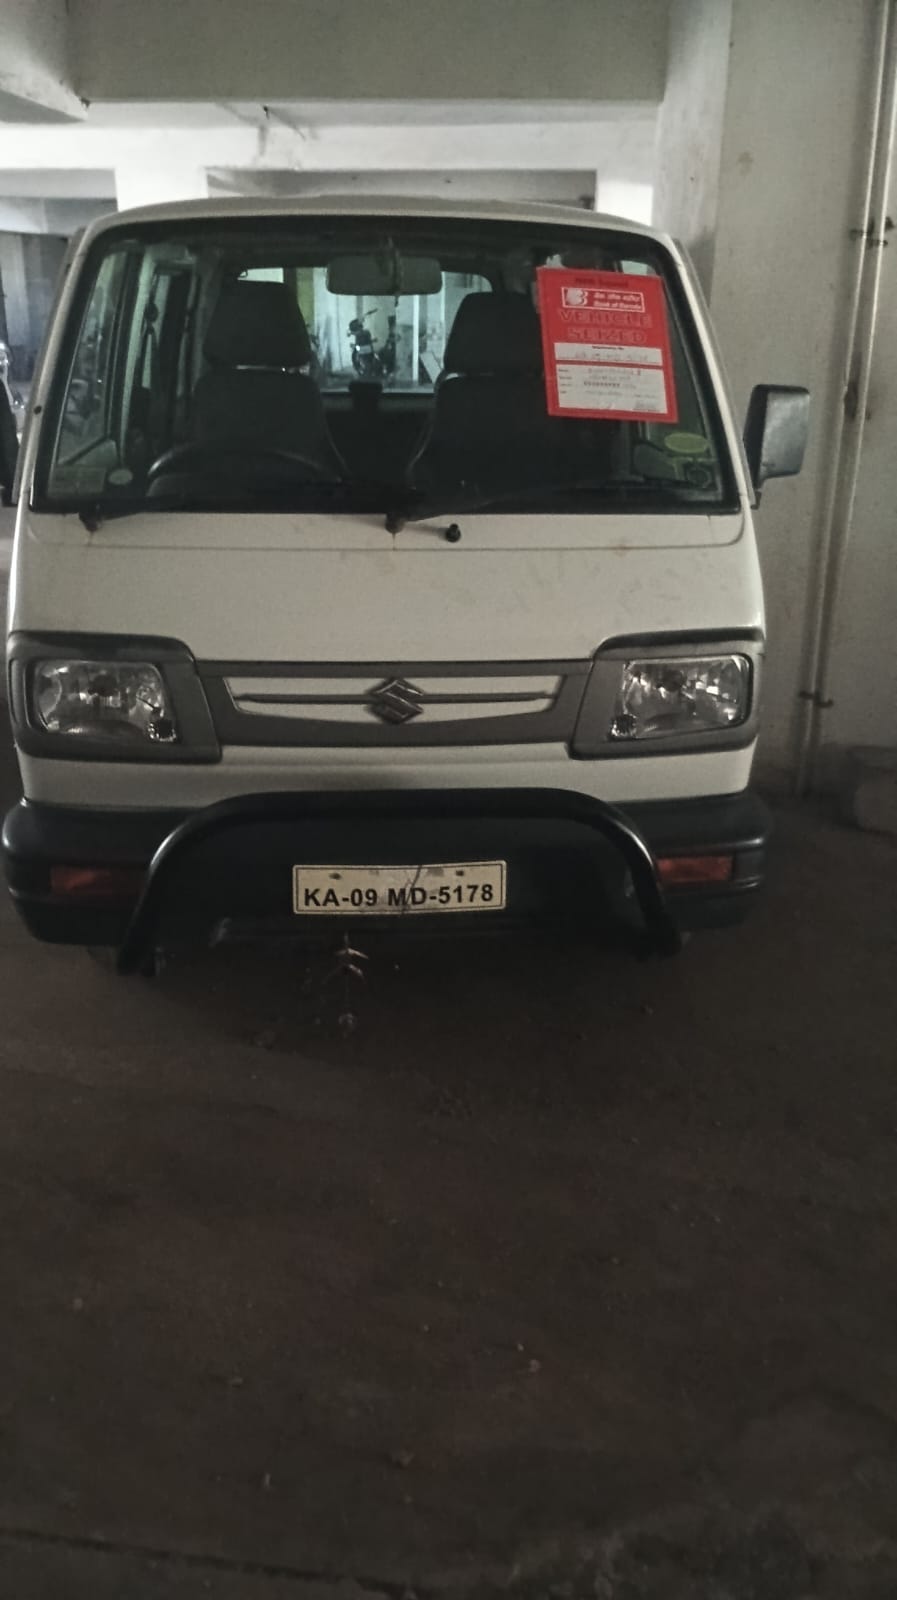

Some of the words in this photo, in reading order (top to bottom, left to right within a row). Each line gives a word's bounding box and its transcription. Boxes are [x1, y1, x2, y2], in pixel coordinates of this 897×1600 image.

[559, 309, 652, 328] VEHICLE
[567, 327, 647, 343] SEIZED
[304, 888, 378, 907] KA-09
[388, 884, 494, 907] MD-5178
